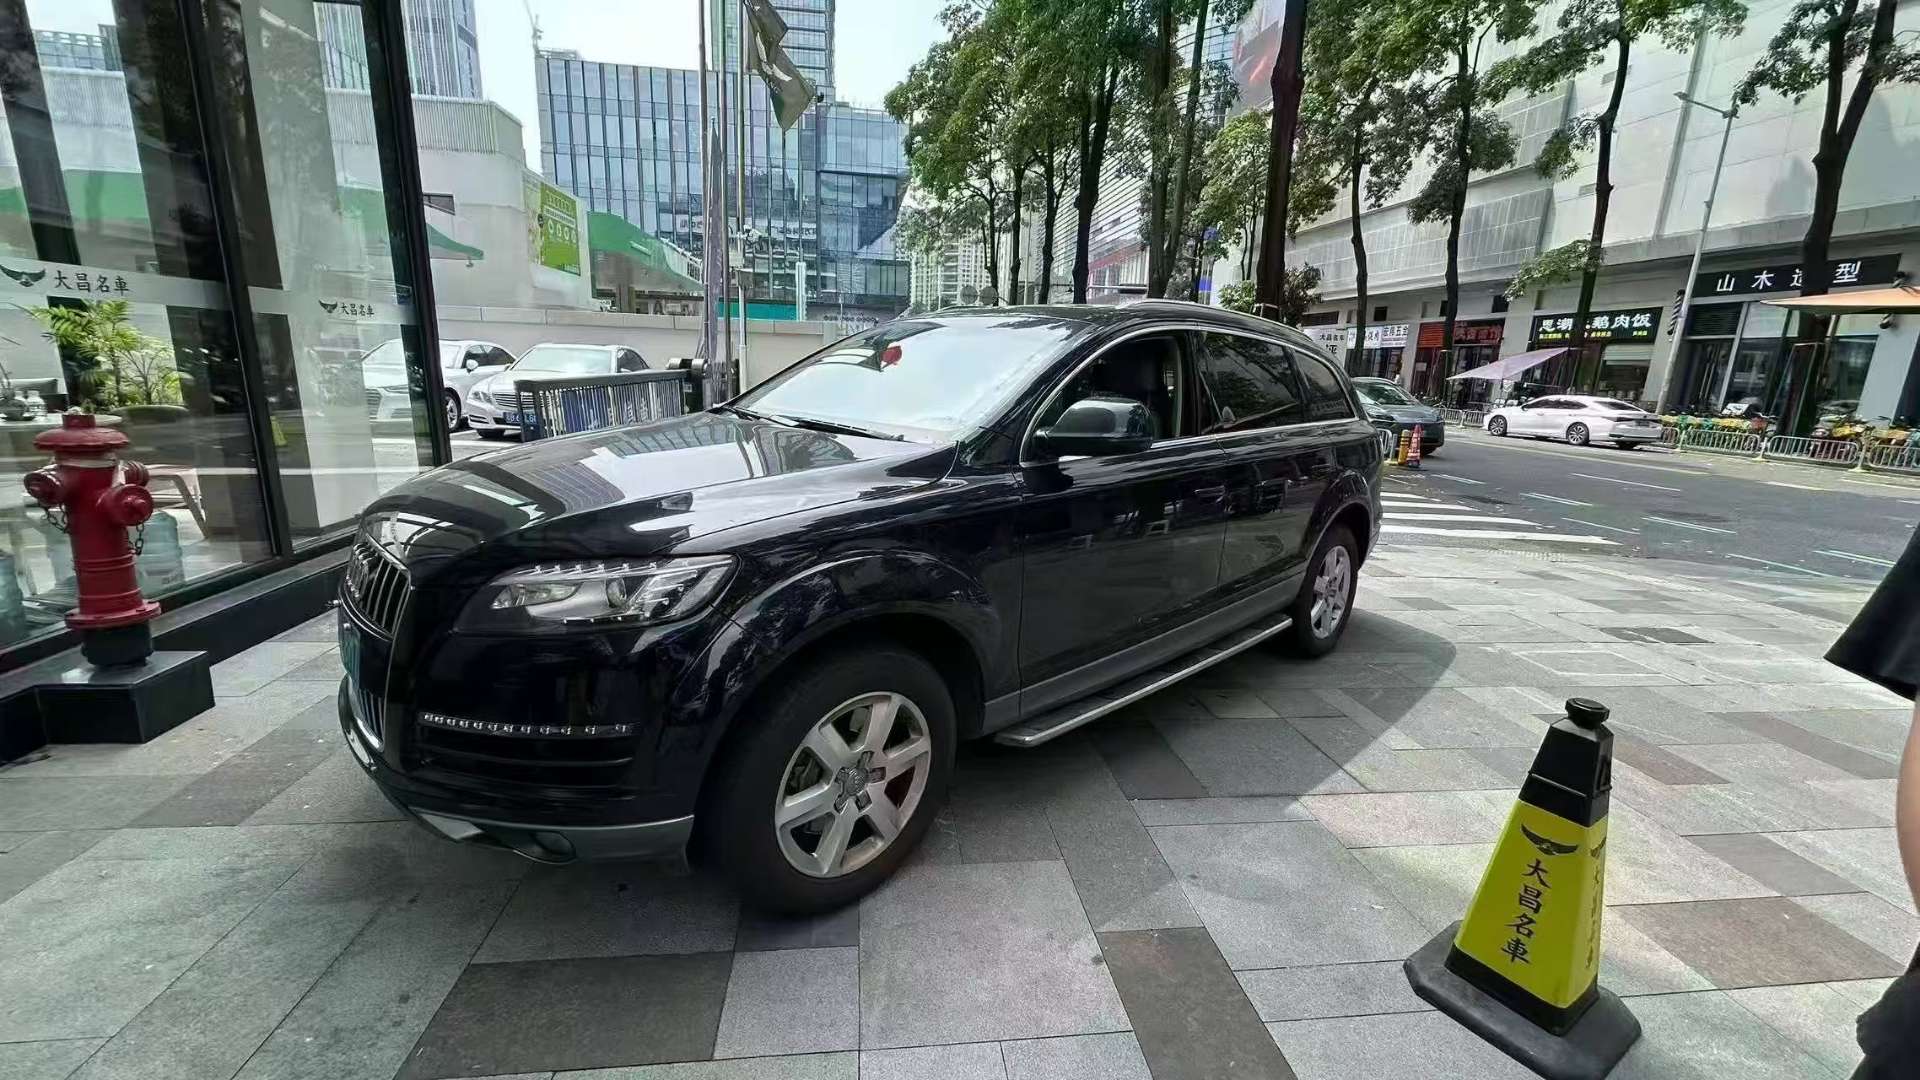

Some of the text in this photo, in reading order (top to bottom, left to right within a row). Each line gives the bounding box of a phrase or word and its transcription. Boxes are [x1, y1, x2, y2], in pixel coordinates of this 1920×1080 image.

[54, 270, 129, 295] 大昌名車
[340, 302, 375, 317] 大昌名車
[1501, 858, 1551, 964] 大昌名車
